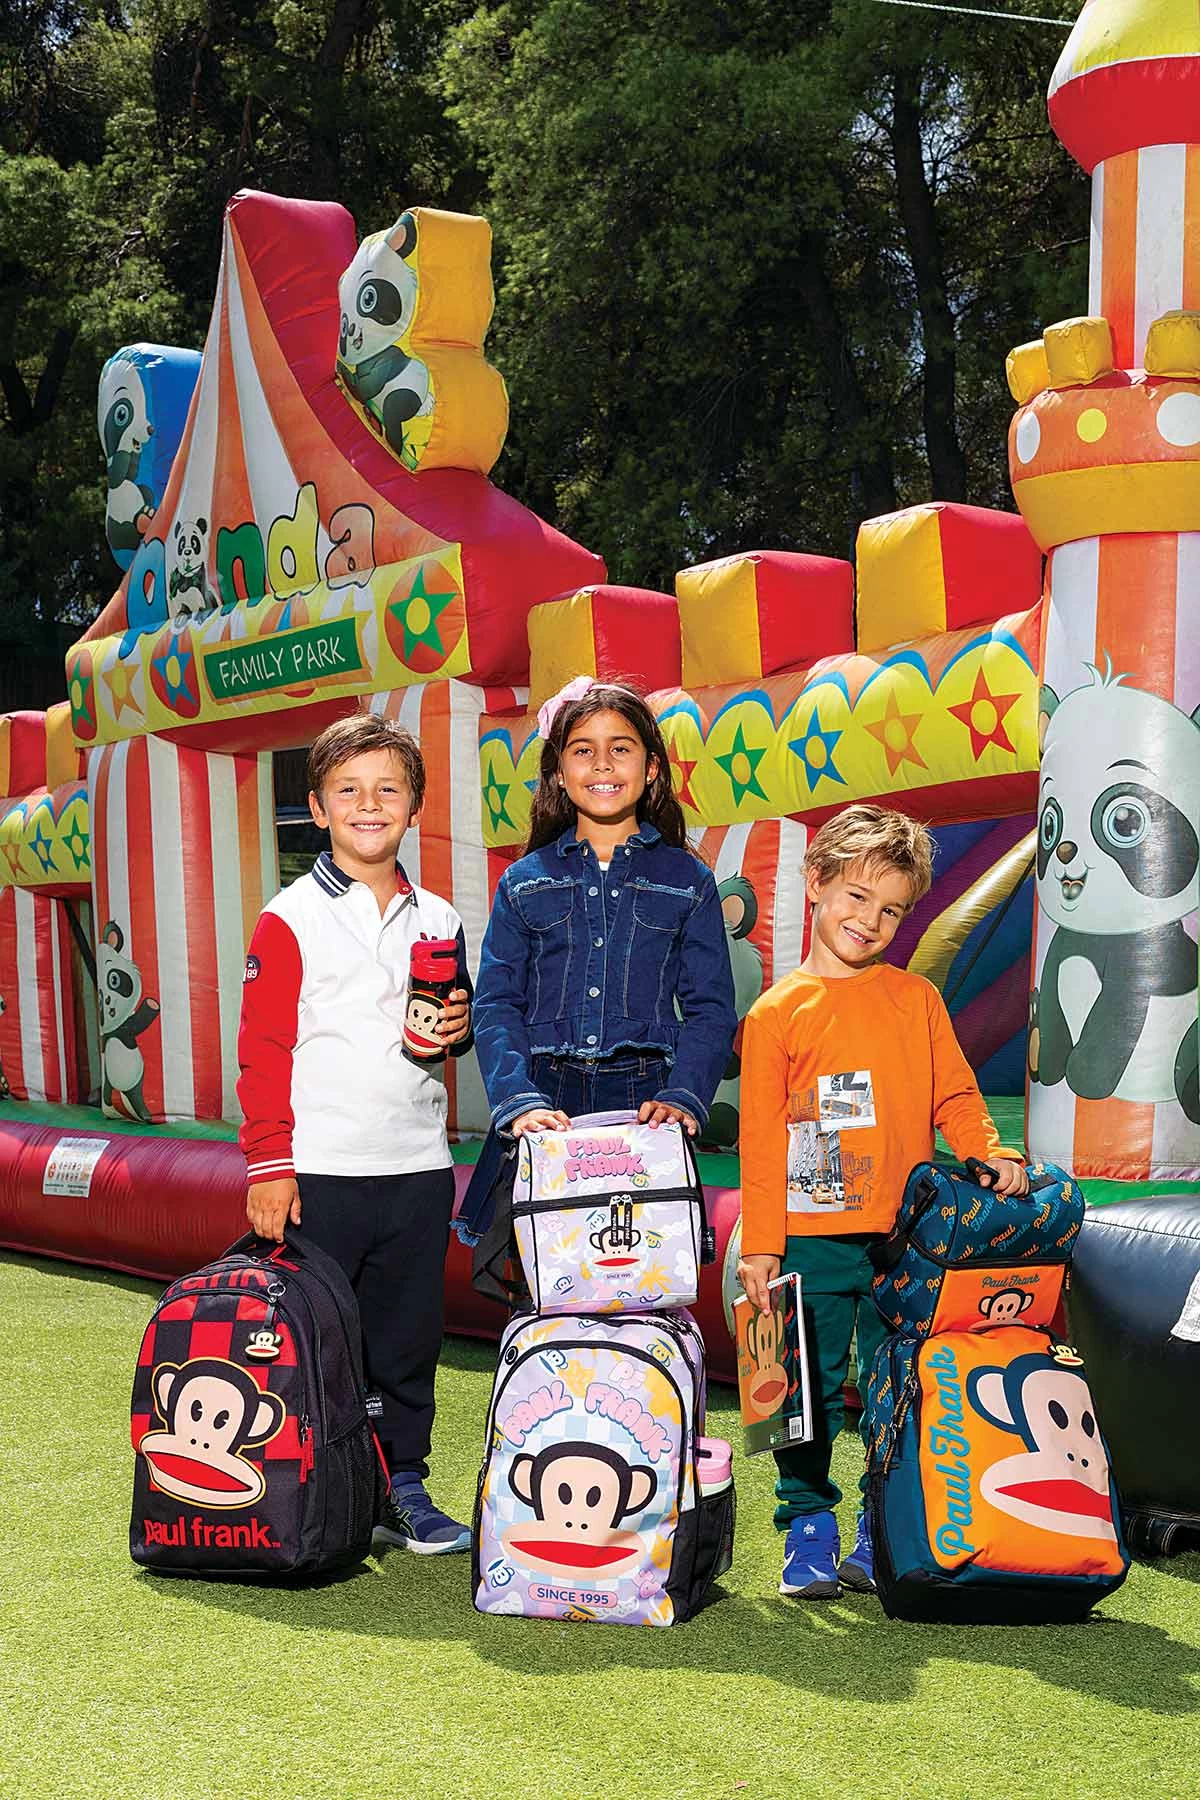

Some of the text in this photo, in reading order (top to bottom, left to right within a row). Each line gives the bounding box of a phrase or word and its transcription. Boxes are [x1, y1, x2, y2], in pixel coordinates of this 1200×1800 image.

[118, 480, 377, 660] pnda
[217, 635, 347, 690] FAMILY PARK
[566, 1136, 632, 1158] PAUL
[564, 1153, 646, 1182] FRANK
[960, 1196, 983, 1228] Paul
[969, 1194, 996, 1233] Frank
[1032, 1202, 1052, 1230] Paul
[989, 1223, 1017, 1248] Paul
[996, 1222, 1031, 1253] Frank
[1055, 1221, 1080, 1248] Paul
[981, 1273, 1041, 1289] Paul Frank
[502, 1379, 673, 1464] PAUL FRANK
[926, 1345, 976, 1557] Paul Frank
[143, 1515, 187, 1548] paul
[536, 1587, 610, 1605] SINCE 1995
